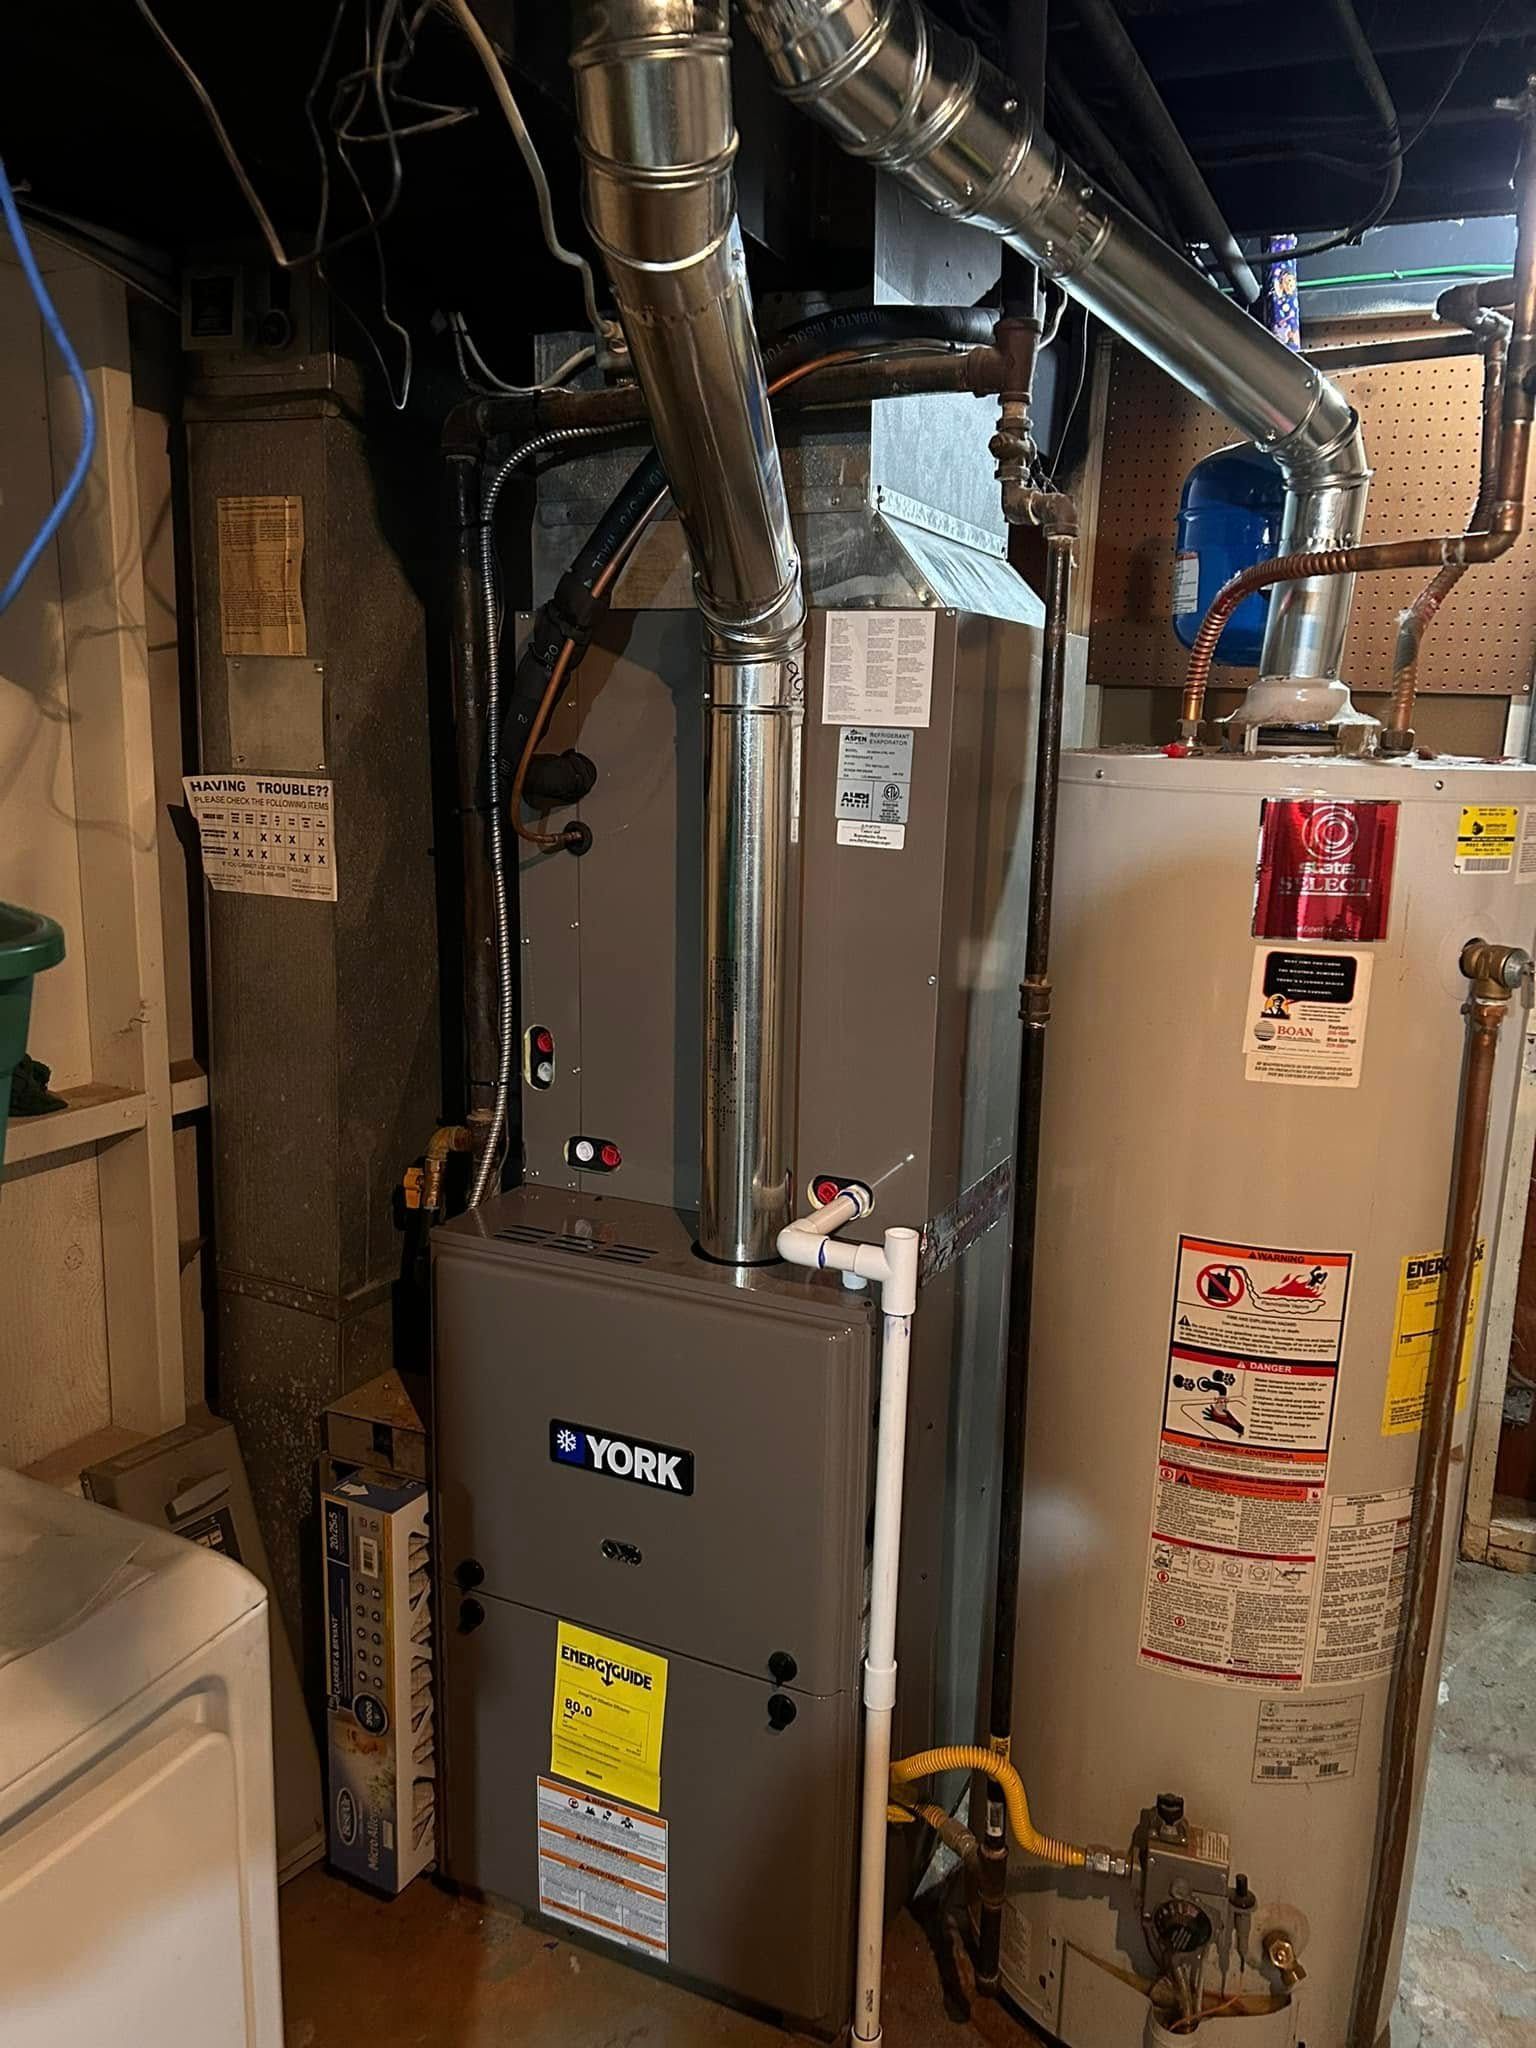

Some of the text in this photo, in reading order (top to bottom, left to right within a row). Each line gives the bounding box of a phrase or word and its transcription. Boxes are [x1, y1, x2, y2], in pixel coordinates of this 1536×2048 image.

[190, 780, 329, 797] HAVING TROUBLE??
[194, 796, 329, 810] PLEASE CHECK THE FOLLOWING ITEMS
[233, 832, 239, 840] X
[260, 834, 267, 842] X
[274, 834, 282, 843] X
[289, 835, 296, 844] X
[318, 838, 325, 846] X
[233, 848, 240, 856] X
[247, 849, 254, 857] X
[261, 850, 268, 859] X
[289, 852, 296, 862] X
[304, 854, 310, 862] X
[318, 855, 325, 864] X
[1298, 861, 1355, 874] state
[1280, 877, 1372, 892] SELECT
[1278, 1026, 1313, 1036] BOAN
[1256, 1252, 1304, 1264] WARNING
[1250, 1362, 1292, 1374] DANGER
[586, 1434, 683, 1490] YORK
[561, 1646, 652, 1690] ENERGYGUIDE
[565, 1698, 592, 1717] 80.0
